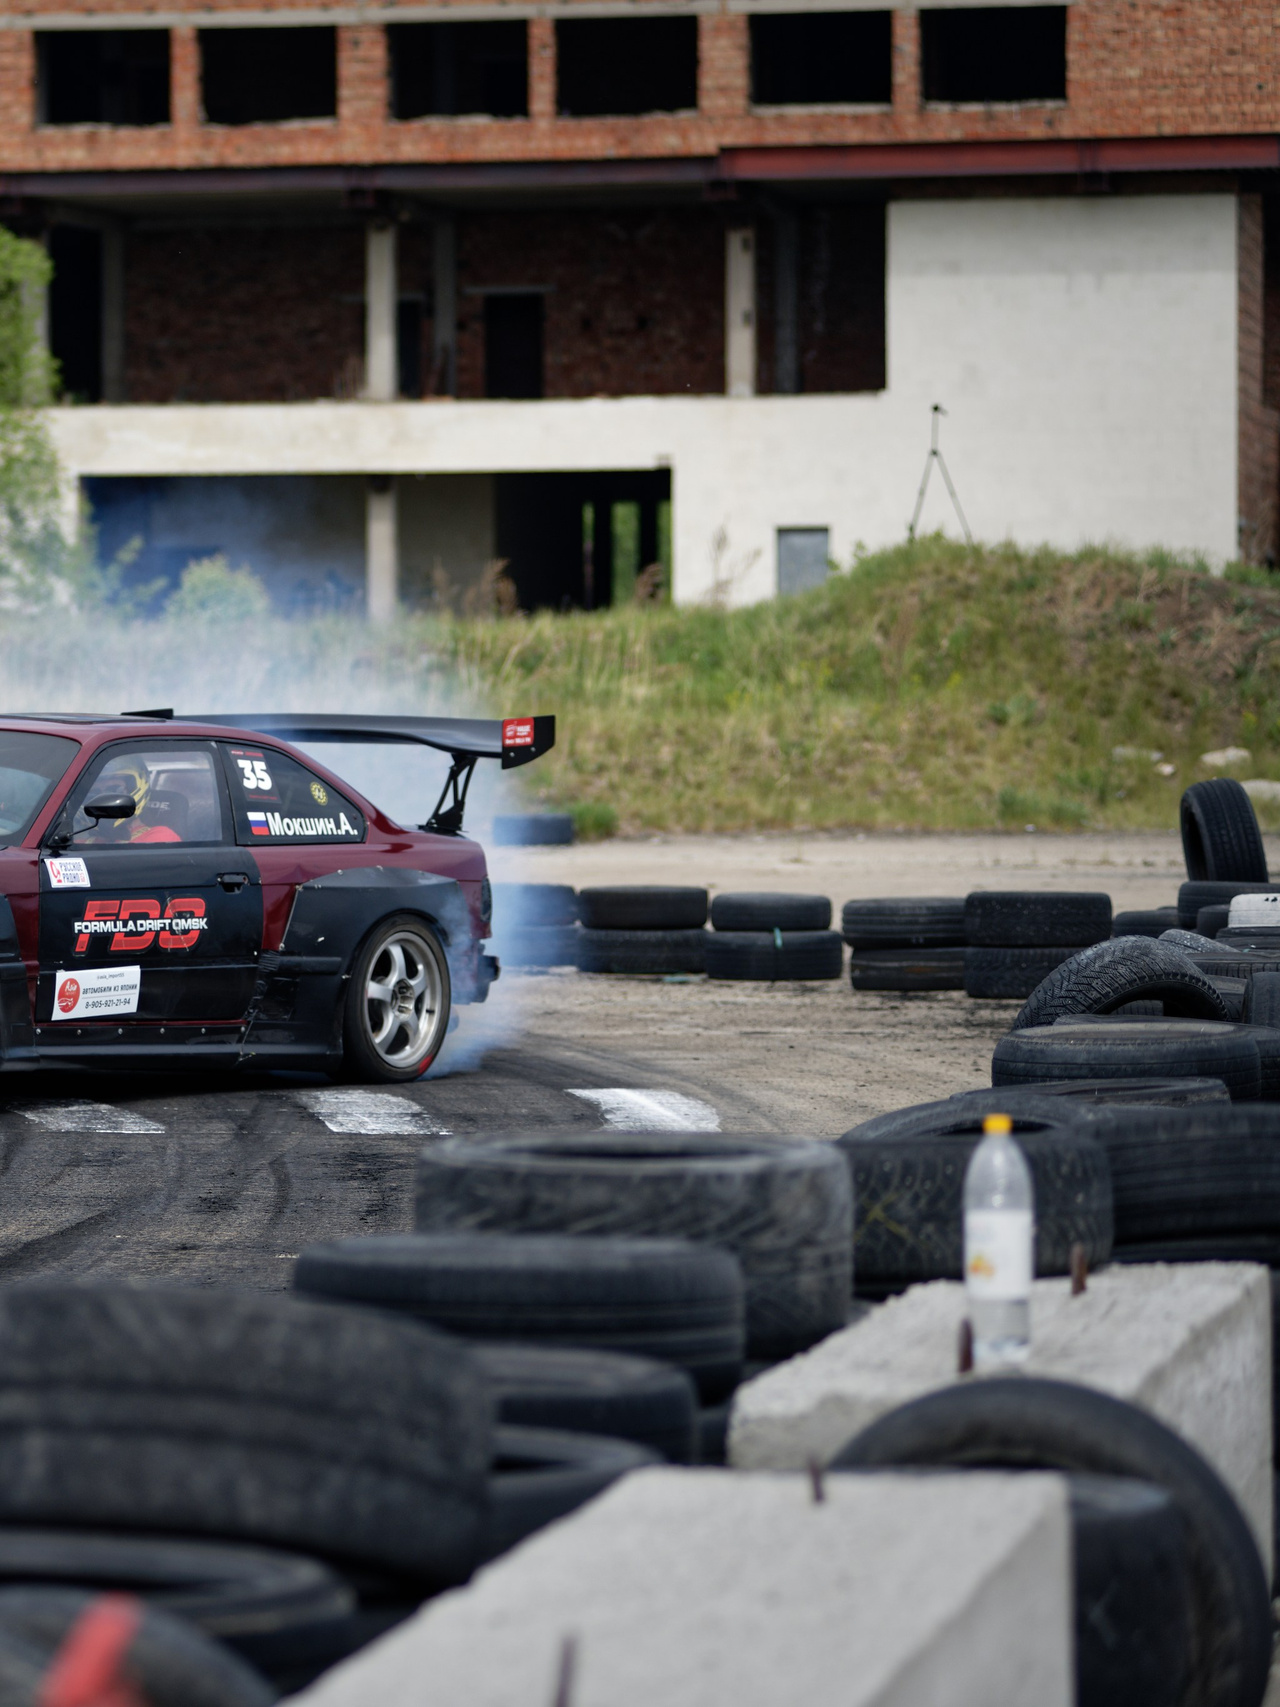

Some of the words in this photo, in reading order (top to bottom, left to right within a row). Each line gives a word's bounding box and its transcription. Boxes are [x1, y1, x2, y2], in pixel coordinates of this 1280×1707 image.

[237, 758, 273, 791] 35
[266, 812, 358, 836] Мокшин.А.
[74, 920, 136, 933] FORMULA
[137, 919, 171, 931] DRIFT
[172, 918, 208, 930] OMSK
